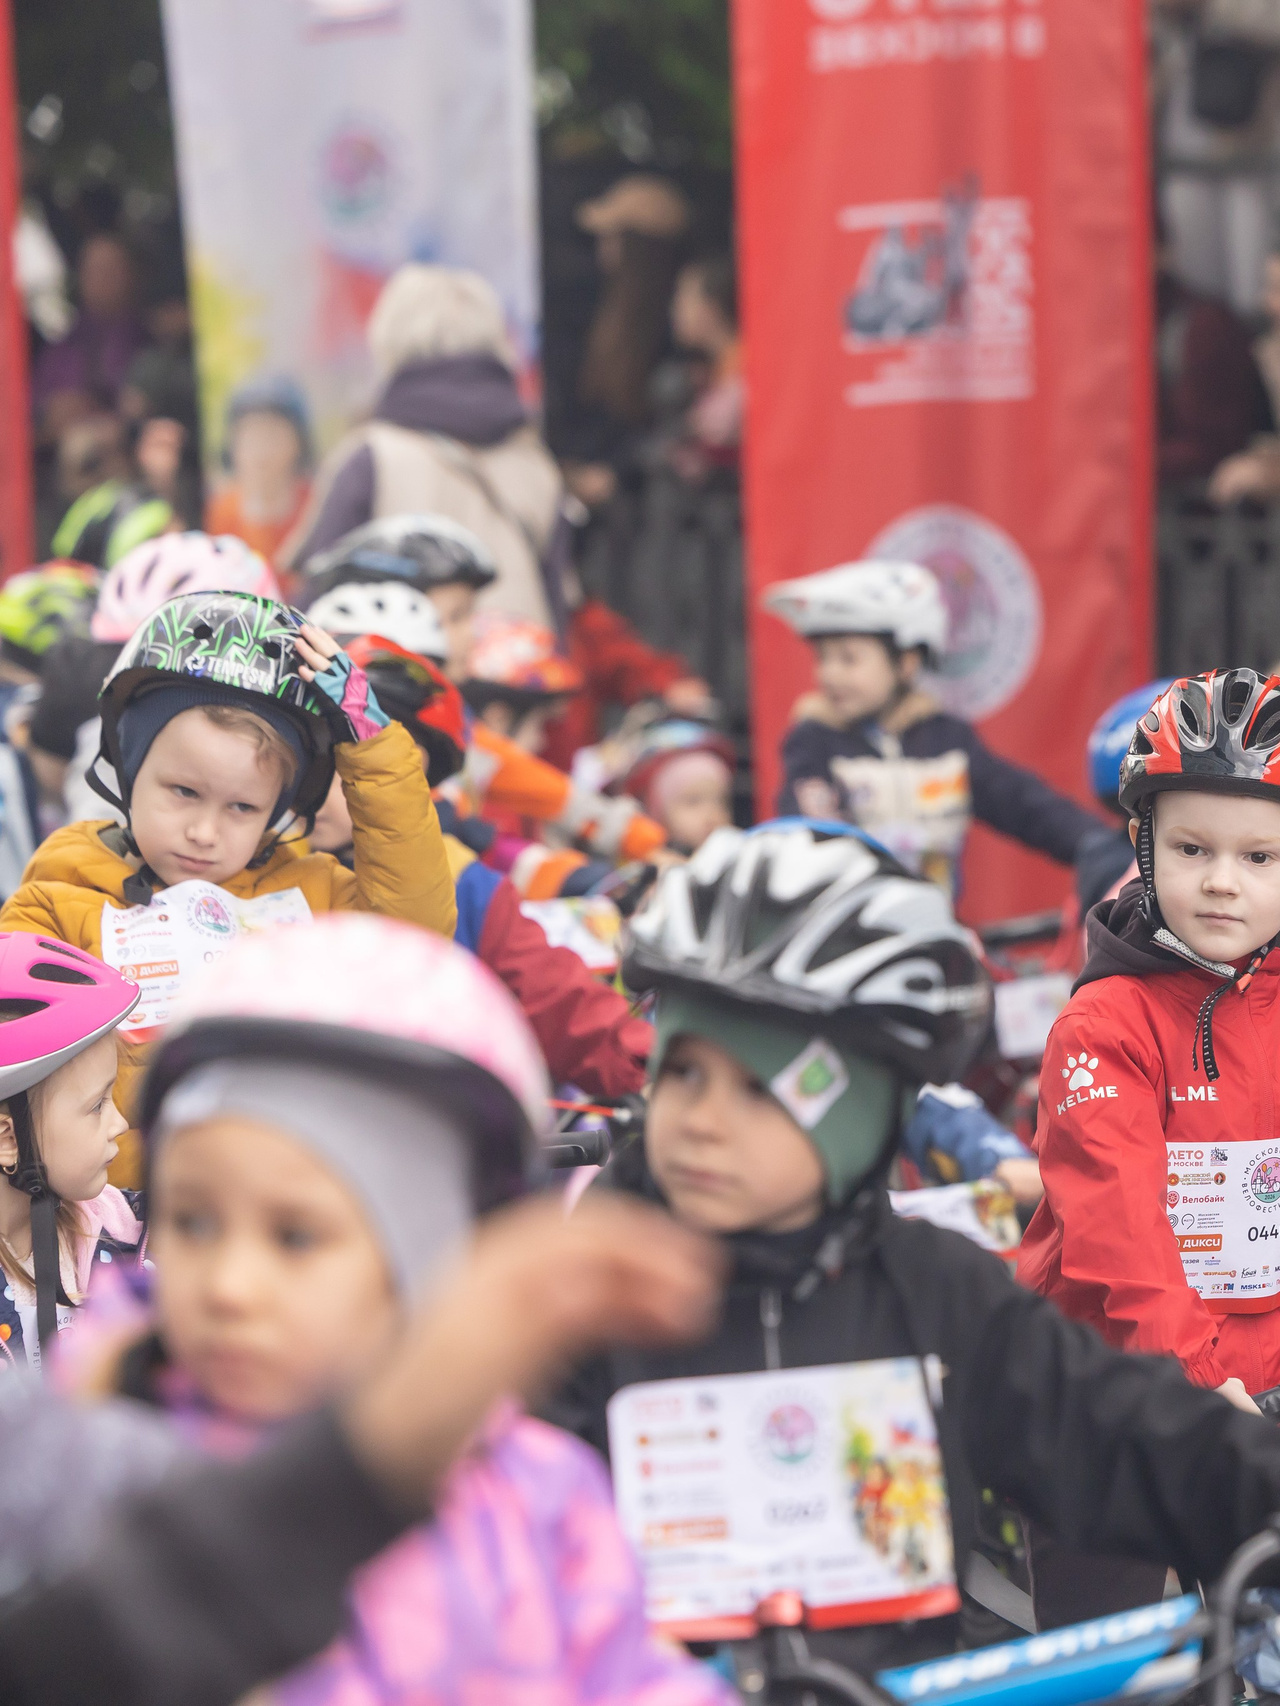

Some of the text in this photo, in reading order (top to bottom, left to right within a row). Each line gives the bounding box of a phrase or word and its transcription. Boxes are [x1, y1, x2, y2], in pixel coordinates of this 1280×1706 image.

[1057, 1085, 1118, 1116] KELME
[1168, 1150, 1204, 1160] ЛЕТО
[1182, 1195, 1225, 1204] Велобайк
